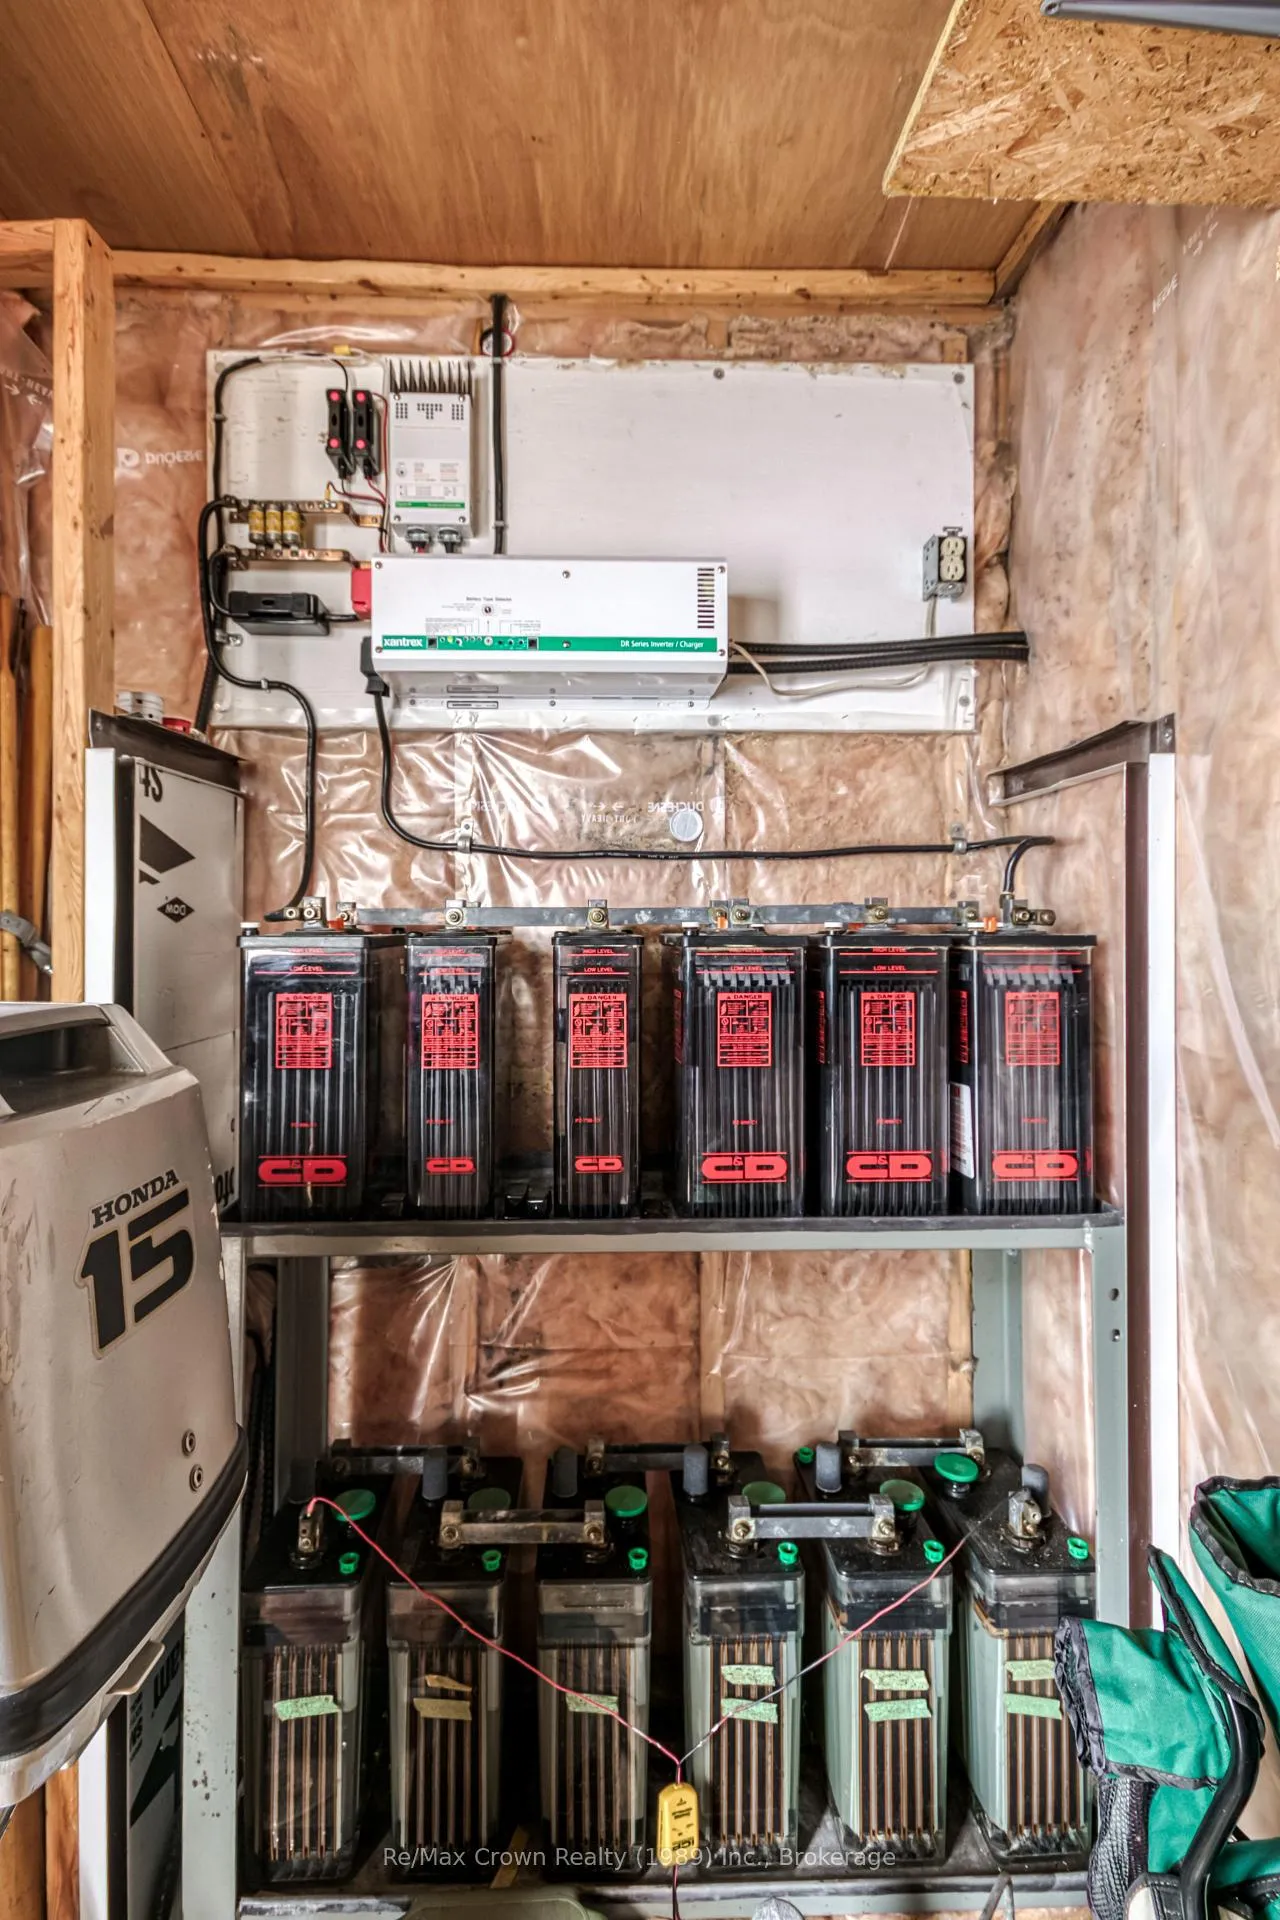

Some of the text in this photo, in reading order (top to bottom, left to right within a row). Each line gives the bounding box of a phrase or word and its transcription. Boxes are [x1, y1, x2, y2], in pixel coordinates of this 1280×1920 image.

[383, 637, 423, 647] xantrex
[620, 640, 630, 648] DR
[631, 640, 649, 648] Series
[650, 640, 674, 648] Inverter
[679, 640, 704, 649] Charger
[165, 904, 186, 916] DOW
[701, 1156, 788, 1180] C&D
[846, 1155, 932, 1179] C&D
[91, 1169, 180, 1229] HONDA
[81, 1187, 194, 1350] 15
